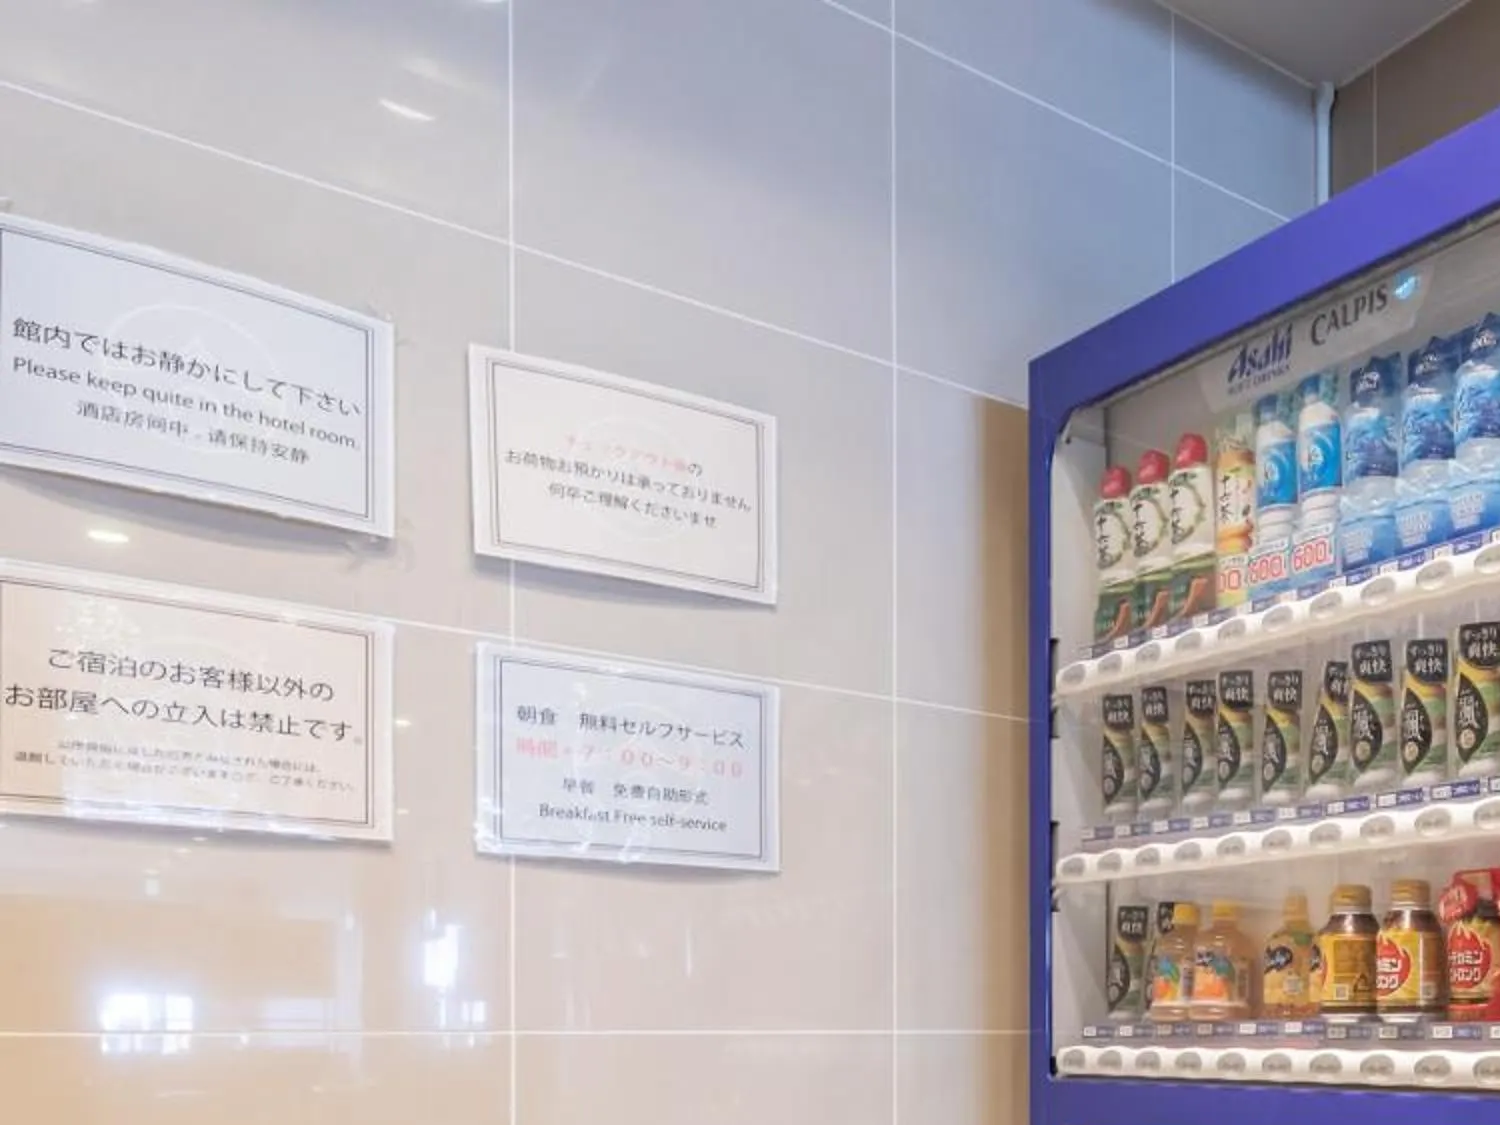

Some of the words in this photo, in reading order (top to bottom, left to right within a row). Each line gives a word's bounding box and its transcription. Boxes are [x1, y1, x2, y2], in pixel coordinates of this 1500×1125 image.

[1310, 284, 1388, 347] CALPIS
[12, 316, 363, 418] 館内ではお静かにして下さい
[1228, 324, 1293, 383] Asahi
[12, 356, 82, 385] Please
[86, 371, 138, 398] keep
[199, 399, 218, 414] in
[223, 403, 254, 425] the
[258, 410, 306, 436] hotel
[47, 647, 335, 703] ご宿泊のお客様以外の
[516, 704, 558, 727] 朝食
[578, 711, 746, 749] 無料セルフサービス
[538, 803, 610, 824] Breakfast
[613, 808, 648, 824] Free
